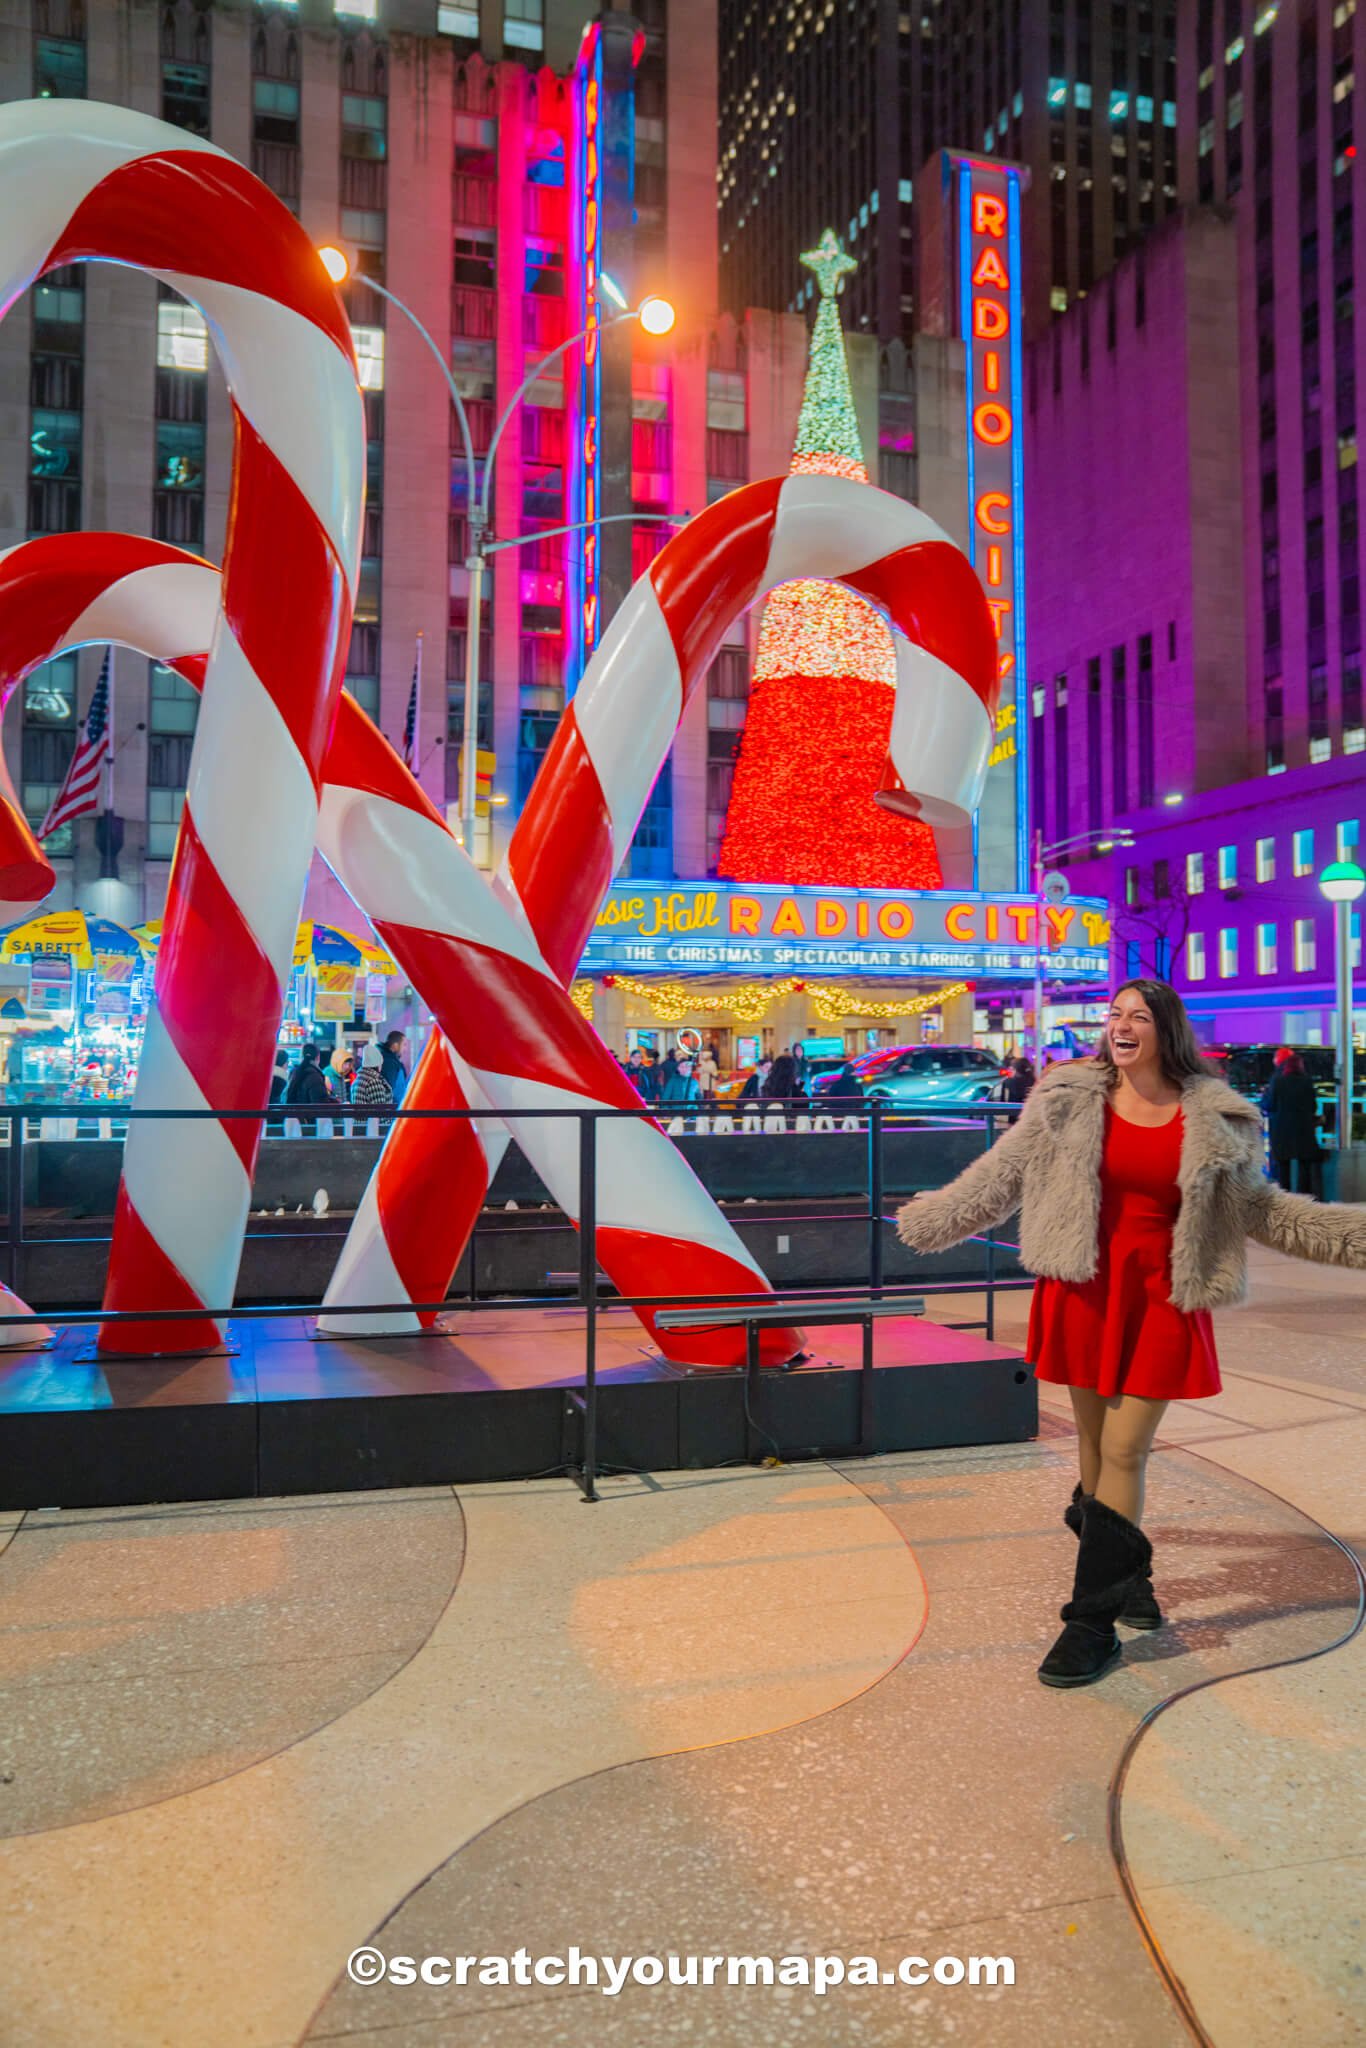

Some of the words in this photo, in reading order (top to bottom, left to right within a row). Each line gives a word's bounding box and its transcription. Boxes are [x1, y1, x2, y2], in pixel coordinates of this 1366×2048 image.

[972, 192, 1013, 445] RADIO
[638, 892, 721, 937] Hall
[729, 895, 915, 938] RADIO
[945, 903, 1076, 943] CITY
[624, 945, 656, 961] THE
[667, 946, 763, 963] CHRISTMAS
[773, 948, 891, 966] SPECTACULAR
[899, 951, 975, 968] STARRING
[984, 953, 1012, 969] THE
